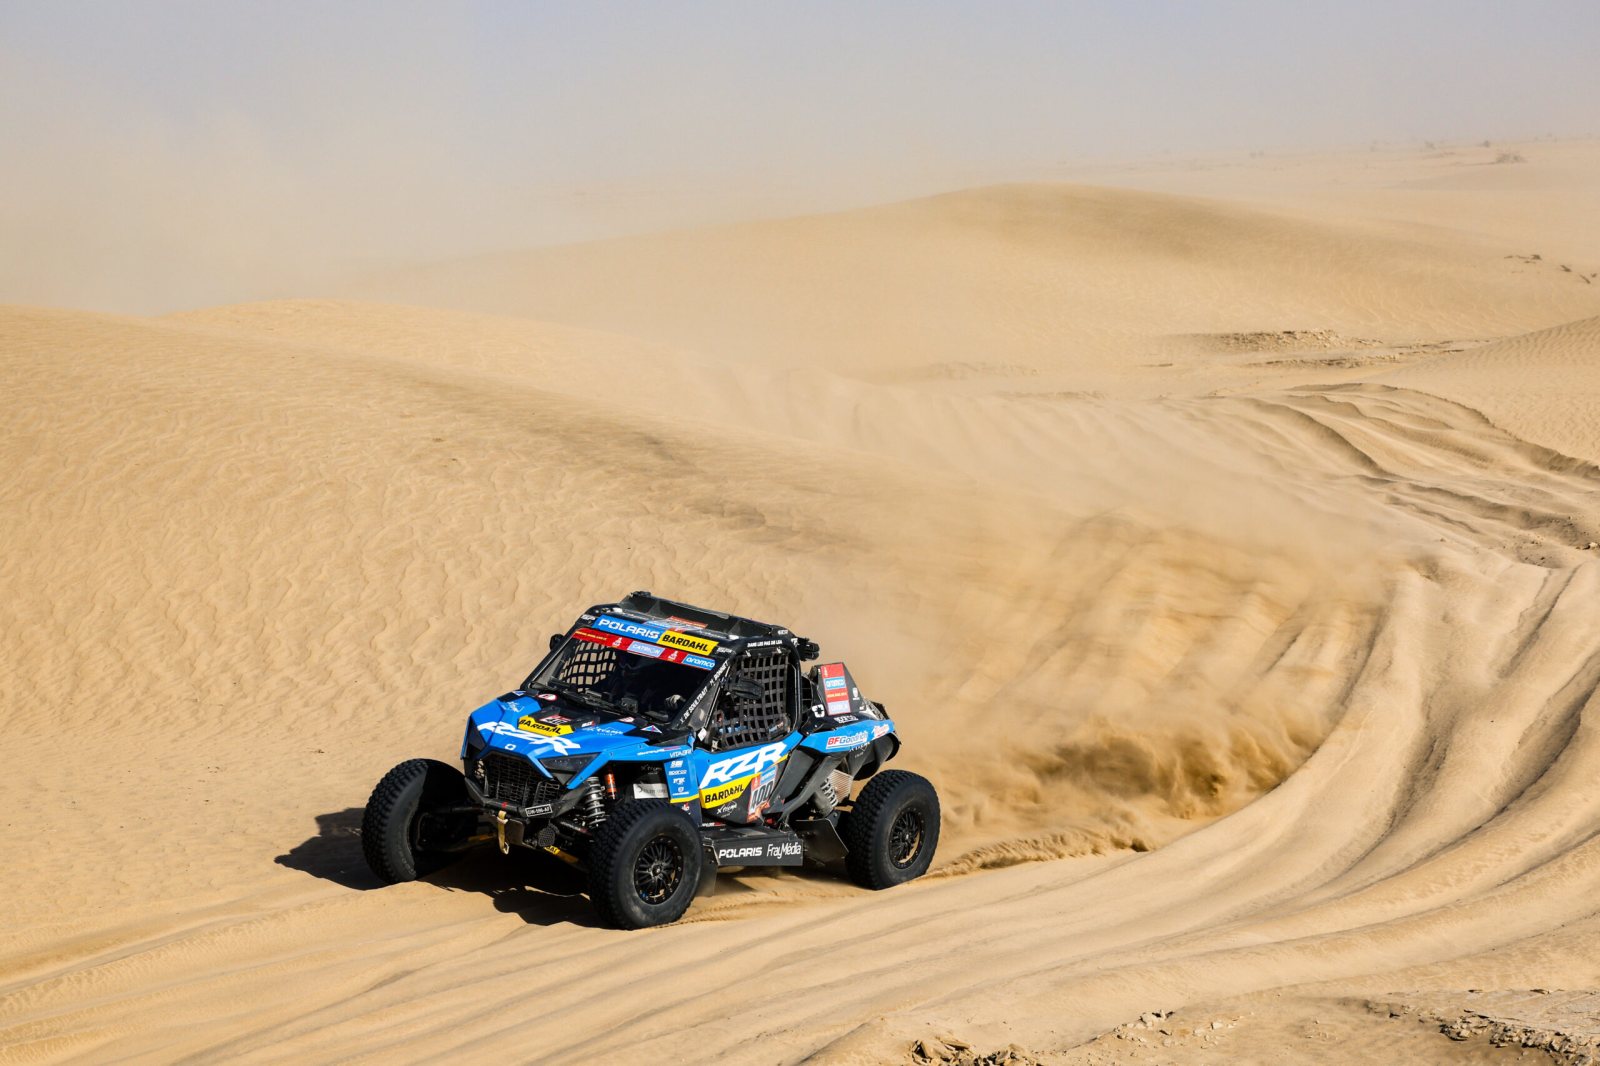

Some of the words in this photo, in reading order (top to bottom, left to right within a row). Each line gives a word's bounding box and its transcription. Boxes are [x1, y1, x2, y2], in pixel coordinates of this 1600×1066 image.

[598, 618, 660, 639] POLARIS
[662, 634, 708, 652] BARDAHL
[686, 656, 715, 669] aramco
[477, 721, 581, 756] RZR
[699, 741, 787, 790] RZR
[705, 784, 745, 804] BARDAHL
[719, 847, 762, 859] POLARIS
[766, 841, 802, 860] FrayMédia
